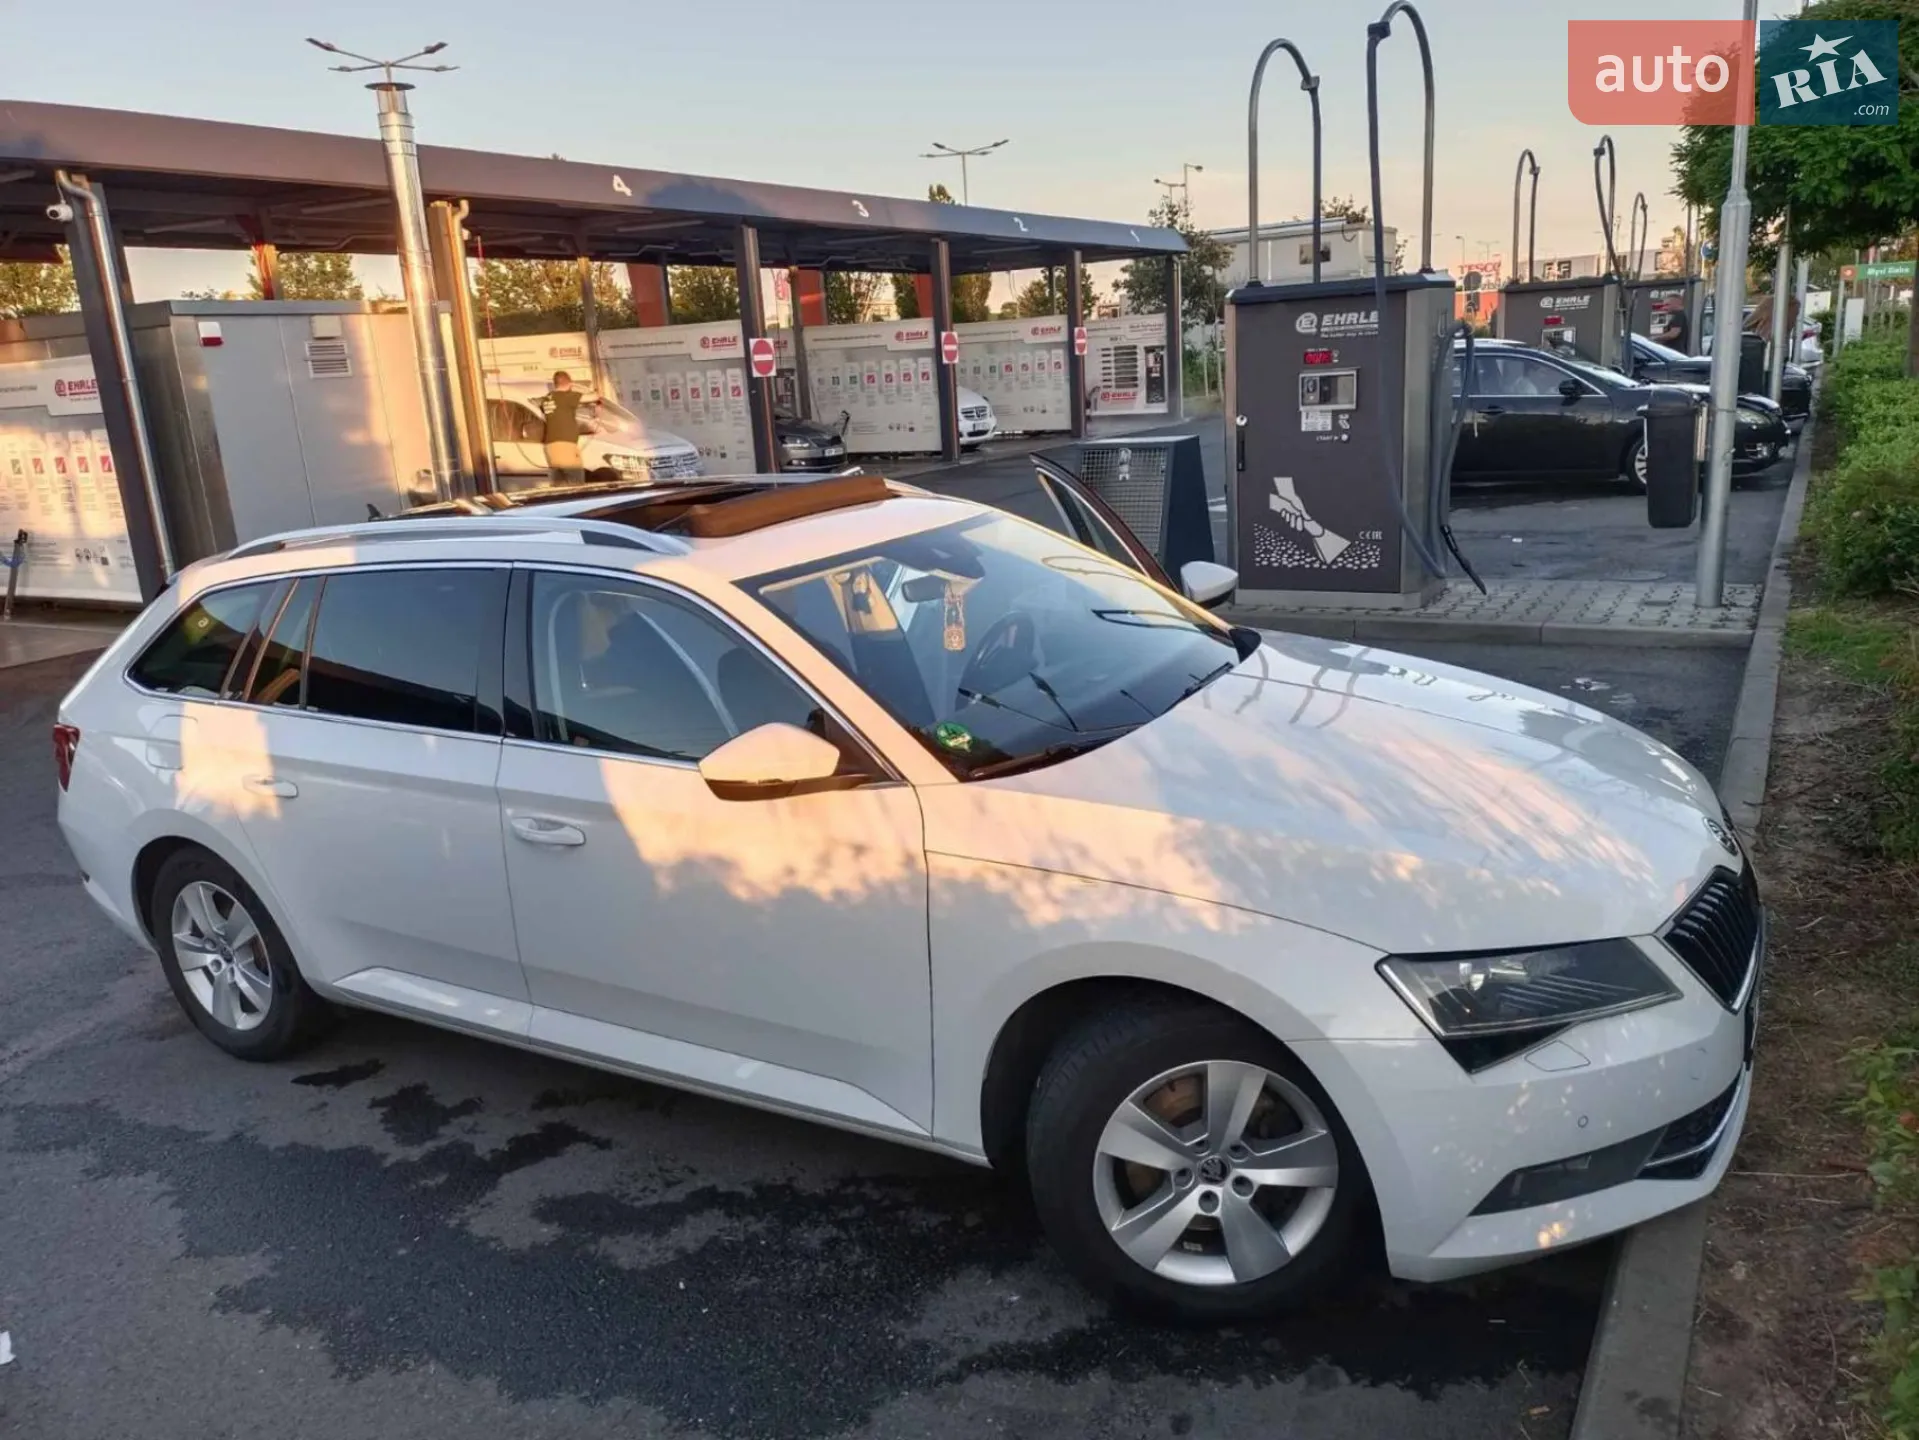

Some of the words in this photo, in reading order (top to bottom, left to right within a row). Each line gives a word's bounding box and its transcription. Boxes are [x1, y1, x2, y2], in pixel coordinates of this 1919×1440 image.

[612, 174, 632, 197] 4
[852, 199, 870, 218] 3
[1014, 216, 1029, 232] 2
[1130, 229, 1141, 243] 1
[1321, 311, 1380, 326] EHRLE
[711, 335, 738, 346] EHRLE
[67, 379, 98, 391] EHRLE
